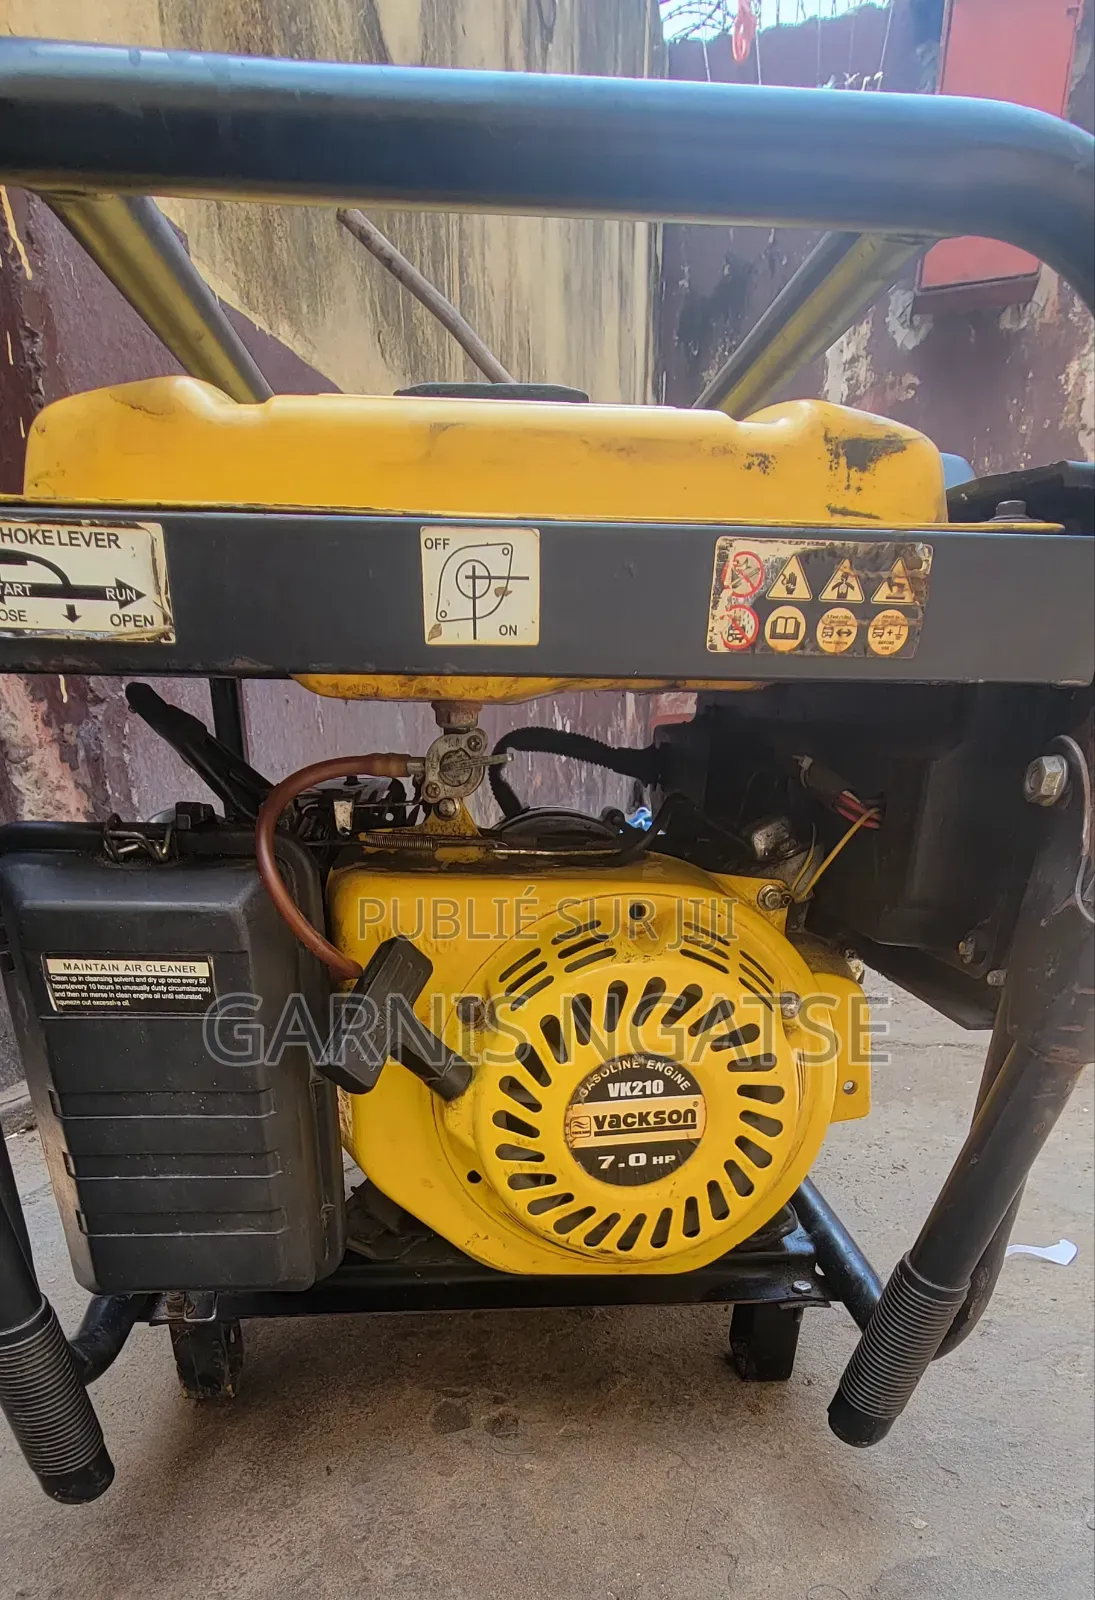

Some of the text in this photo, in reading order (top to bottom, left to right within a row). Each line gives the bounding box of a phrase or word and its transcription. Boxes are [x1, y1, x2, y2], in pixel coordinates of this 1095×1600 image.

[57, 530, 122, 549] LEVER
[424, 537, 450, 550] OFF
[105, 587, 137, 601] RUN
[110, 613, 155, 628] OPEN
[498, 624, 518, 636] ON
[63, 962, 197, 974] MAINTAIN AIR CLEANER
[84, 975, 112, 984] cleansing
[578, 1059, 691, 1098] GASOLINE ENGINE
[607, 1079, 664, 1098] VK210
[597, 1152, 676, 1170] 7.0 HP
